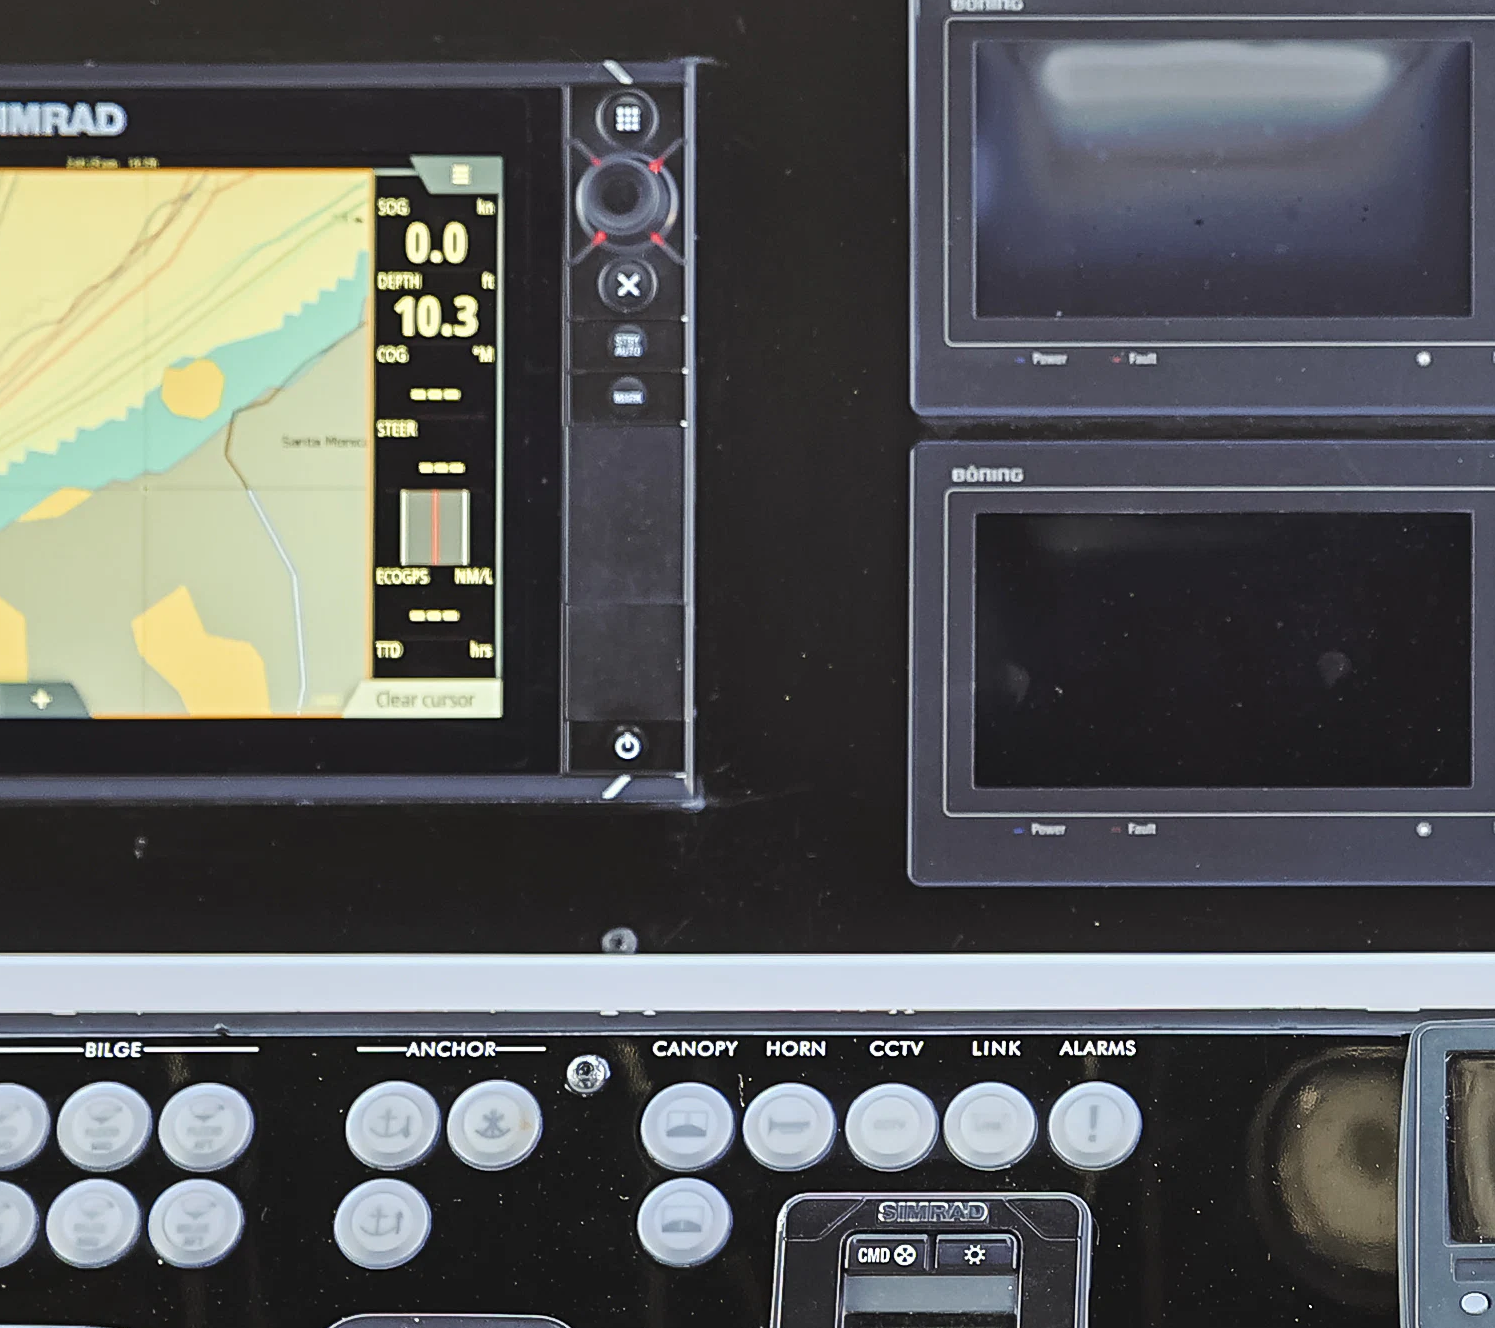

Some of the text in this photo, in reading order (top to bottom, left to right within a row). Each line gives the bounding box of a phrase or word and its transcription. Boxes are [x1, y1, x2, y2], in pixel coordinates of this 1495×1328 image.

[377, 197, 495, 217] SOG kn
[405, 220, 469, 265] 0.0
[377, 271, 496, 291] DEPTH ft
[393, 294, 480, 339] 10.3
[376, 345, 409, 364] COG
[1032, 353, 1068, 366] Power
[1128, 352, 1157, 365] Fault
[376, 420, 418, 439] STEER
[281, 434, 321, 449] Santa
[454, 567, 493, 585] NM/L
[470, 640, 493, 659] hrs
[375, 690, 475, 709] Clear cursor
[1031, 823, 1067, 837] Power
[1128, 823, 1156, 836] Fault
[85, 1041, 142, 1058] BILGE
[406, 1041, 496, 1057] ANCHOR
[653, 1040, 737, 1057] CANOPY
[766, 1040, 826, 1056] HORN
[869, 1040, 924, 1057] CCTV
[972, 1040, 1021, 1056] LINK
[1059, 1040, 1136, 1056] ALARMS
[878, 1201, 989, 1222] SIMRAD
[858, 1247, 890, 1263] CMD
